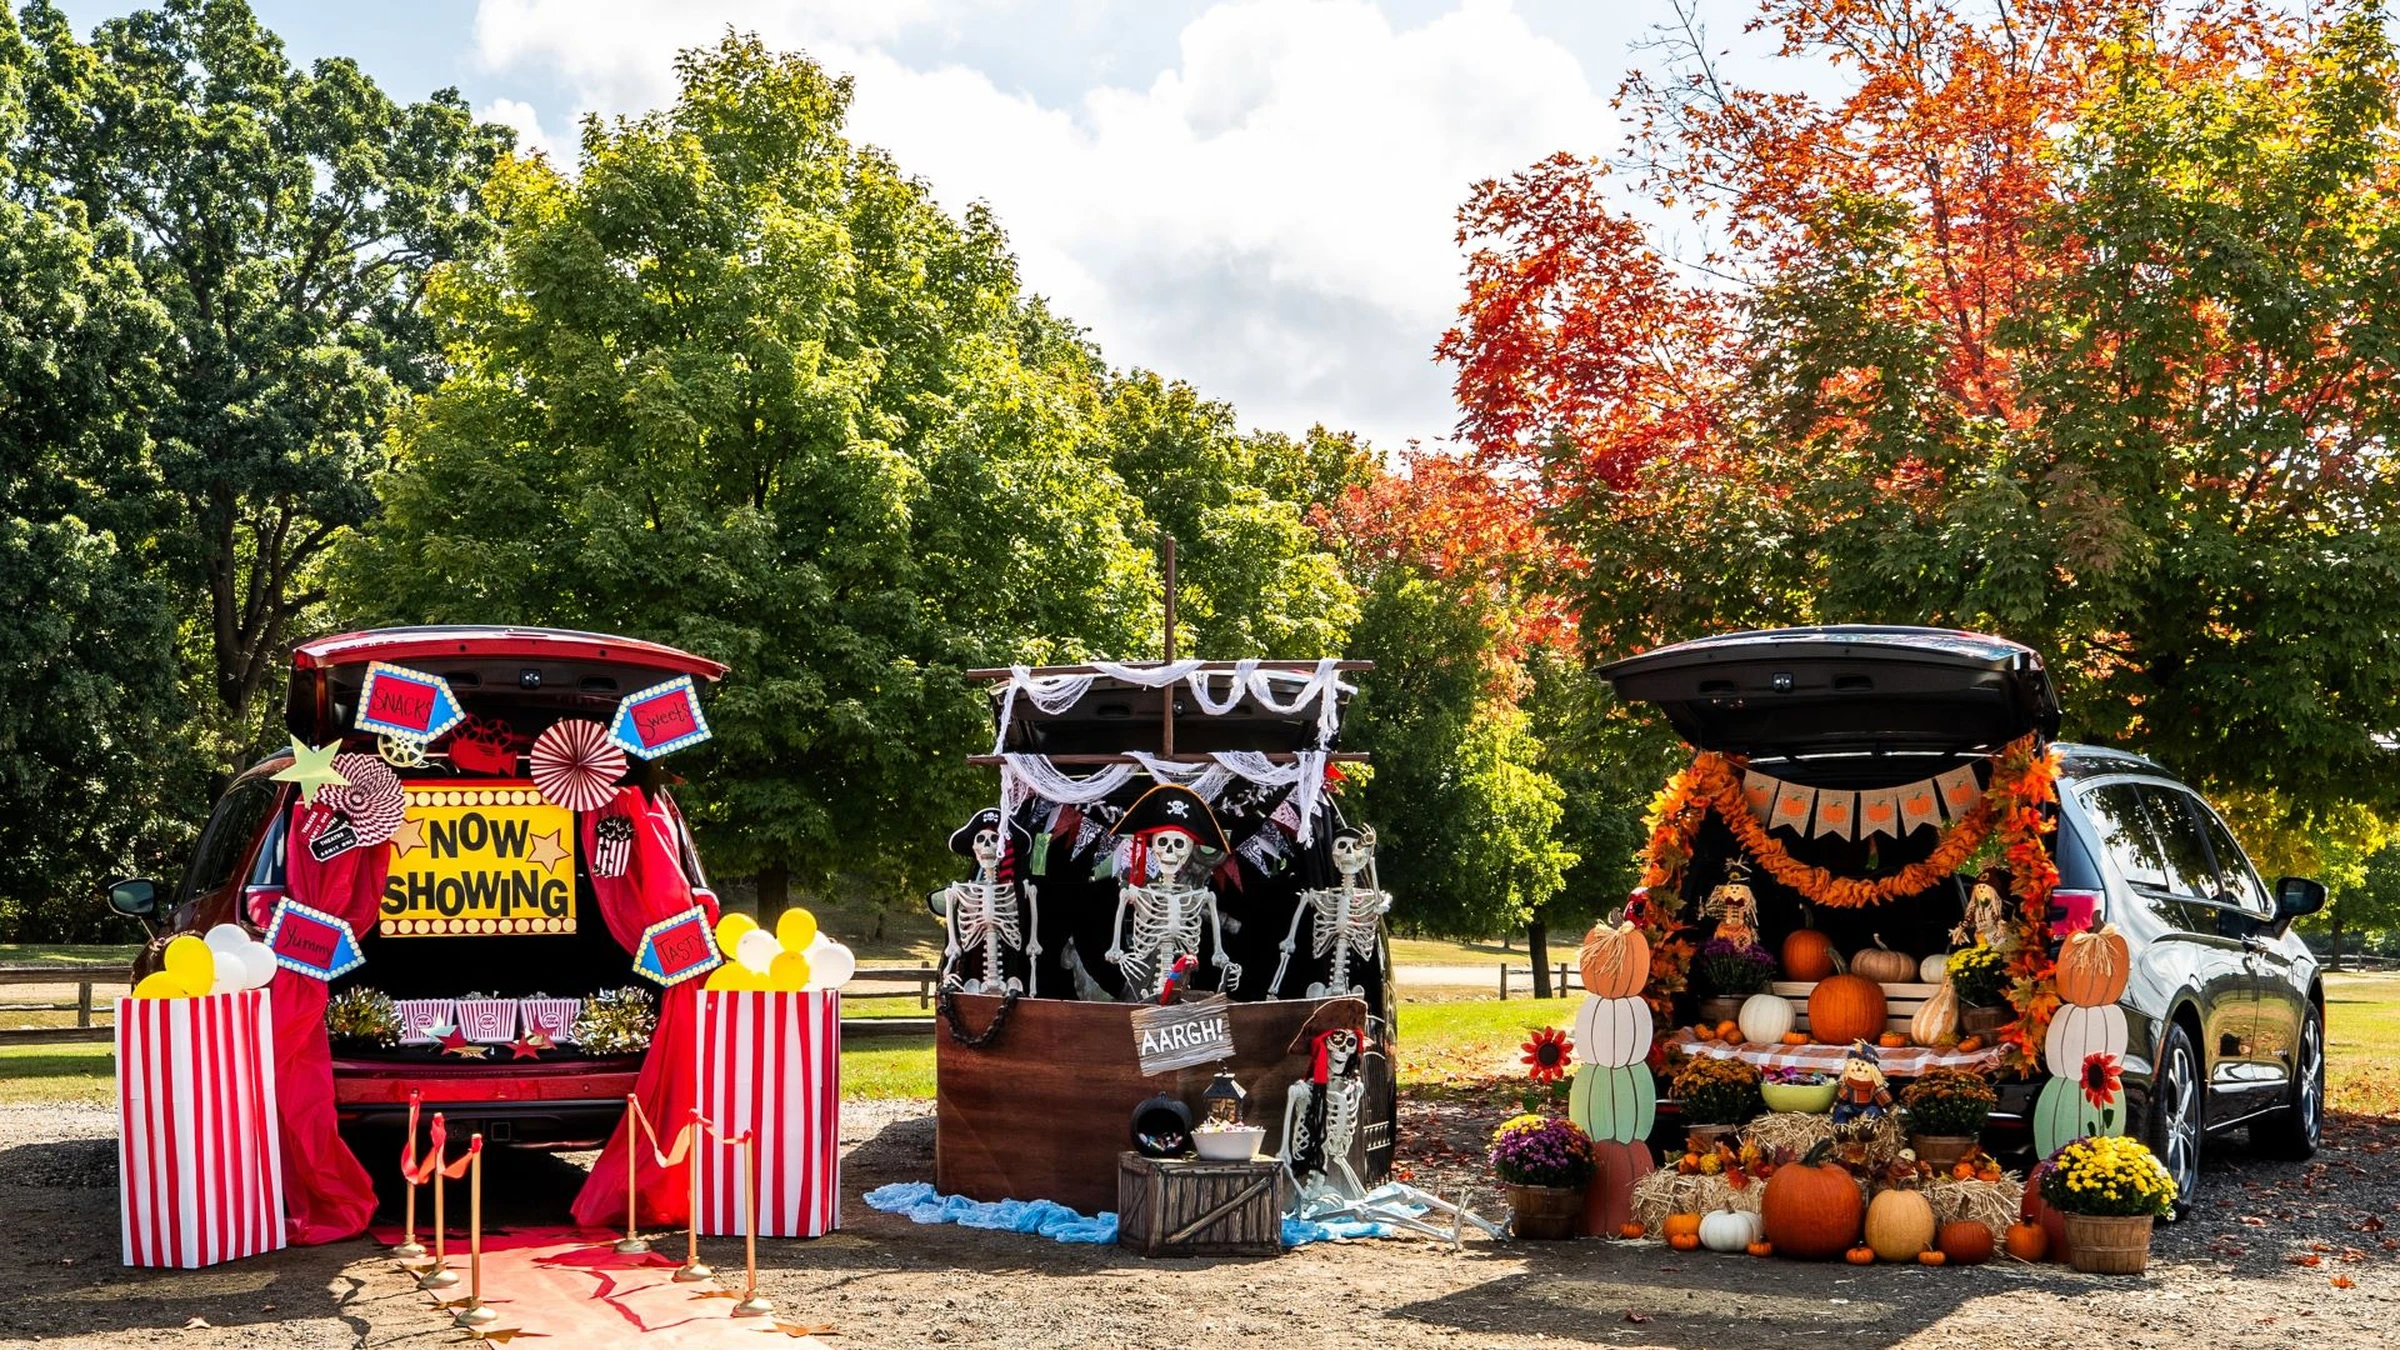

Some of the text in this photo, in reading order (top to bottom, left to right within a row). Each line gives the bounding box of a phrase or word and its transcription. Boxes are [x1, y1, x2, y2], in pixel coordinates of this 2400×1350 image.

[372, 687, 431, 723] SNACKS
[635, 701, 691, 741] Sweets
[301, 811, 318, 833] THEATRE
[320, 832, 344, 846] THEATRE
[429, 812, 529, 859] NOW
[320, 839, 354, 857] ADMIT ONE
[380, 870, 568, 917] SHOWING
[283, 921, 332, 962] Yummy
[656, 935, 703, 965] TASTY
[1141, 1018, 1222, 1056] AARGH!
